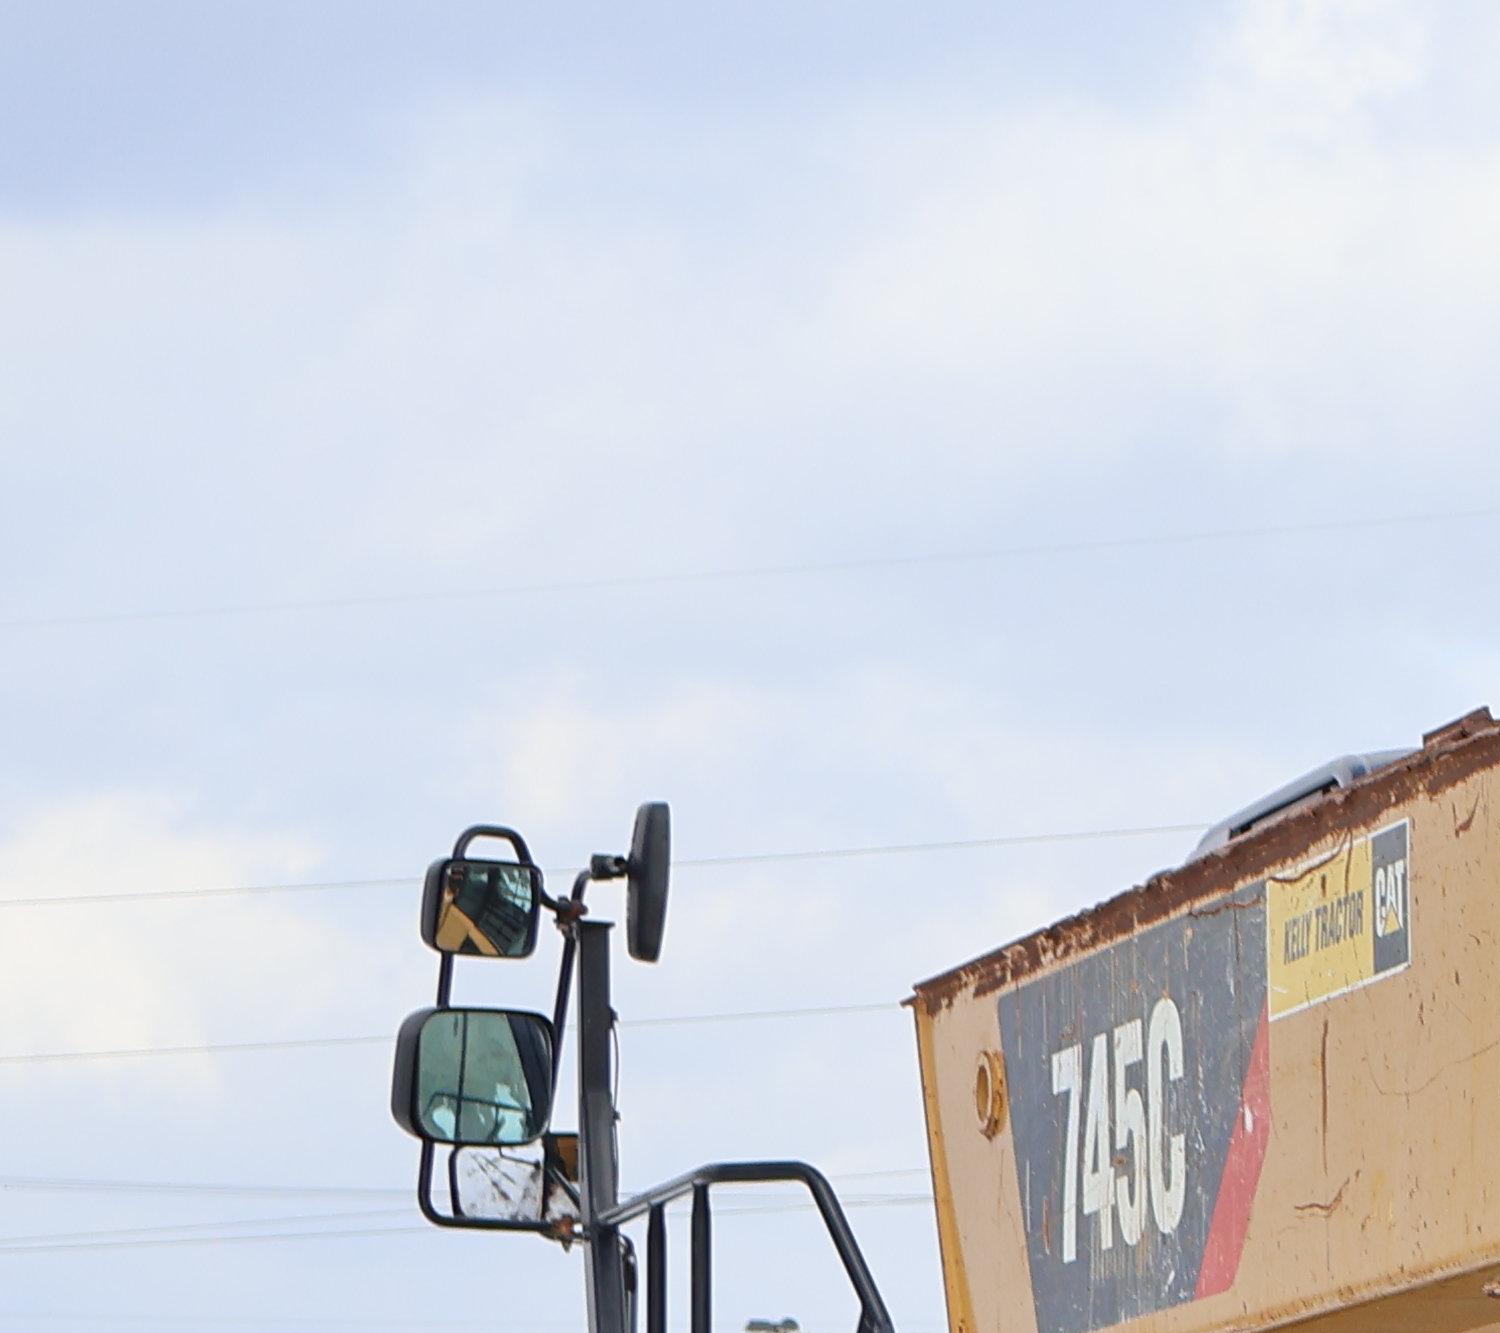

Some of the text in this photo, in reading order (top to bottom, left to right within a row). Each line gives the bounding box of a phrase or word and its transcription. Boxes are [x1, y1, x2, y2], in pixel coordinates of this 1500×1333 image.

[1284, 890, 1365, 965] KELLY TRACTOR
[1375, 859, 1404, 939] CAT
[1051, 997, 1187, 1263] 745C
